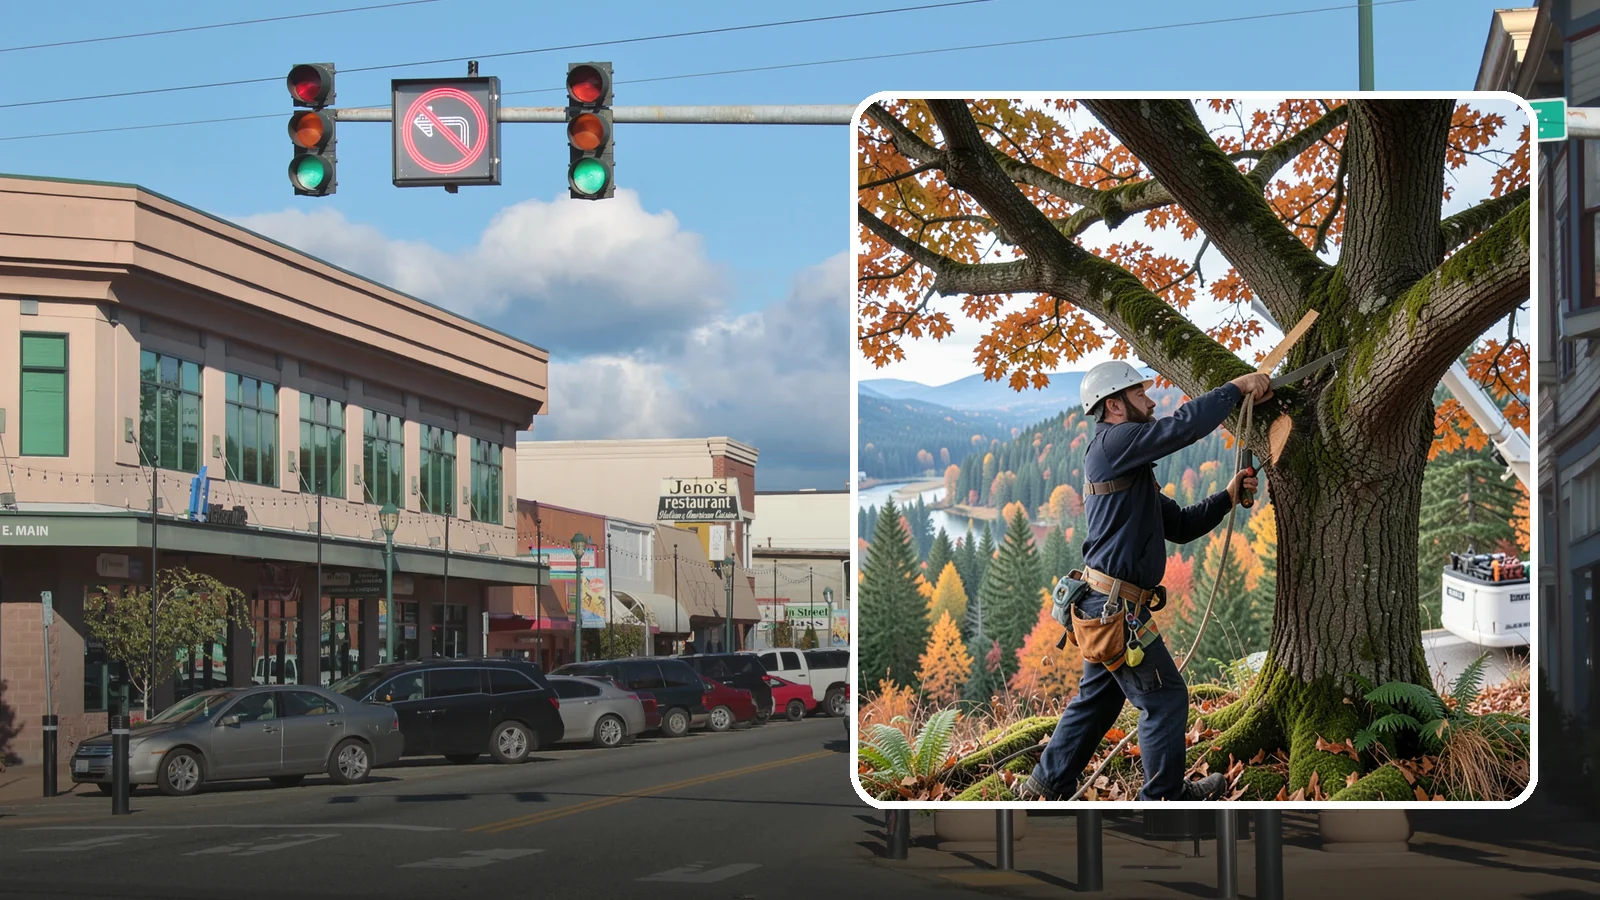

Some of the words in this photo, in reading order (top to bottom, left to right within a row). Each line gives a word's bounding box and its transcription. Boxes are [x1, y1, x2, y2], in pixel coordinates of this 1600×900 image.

[670, 480, 727, 494] Jeno's
[665, 496, 730, 509] restaurant
[658, 510, 681, 519] Italian
[686, 510, 714, 519] American
[715, 510, 737, 519] Cuisine
[2, 525, 13, 536] E.
[15, 525, 49, 536] MAIN
[797, 608, 828, 616] Street
